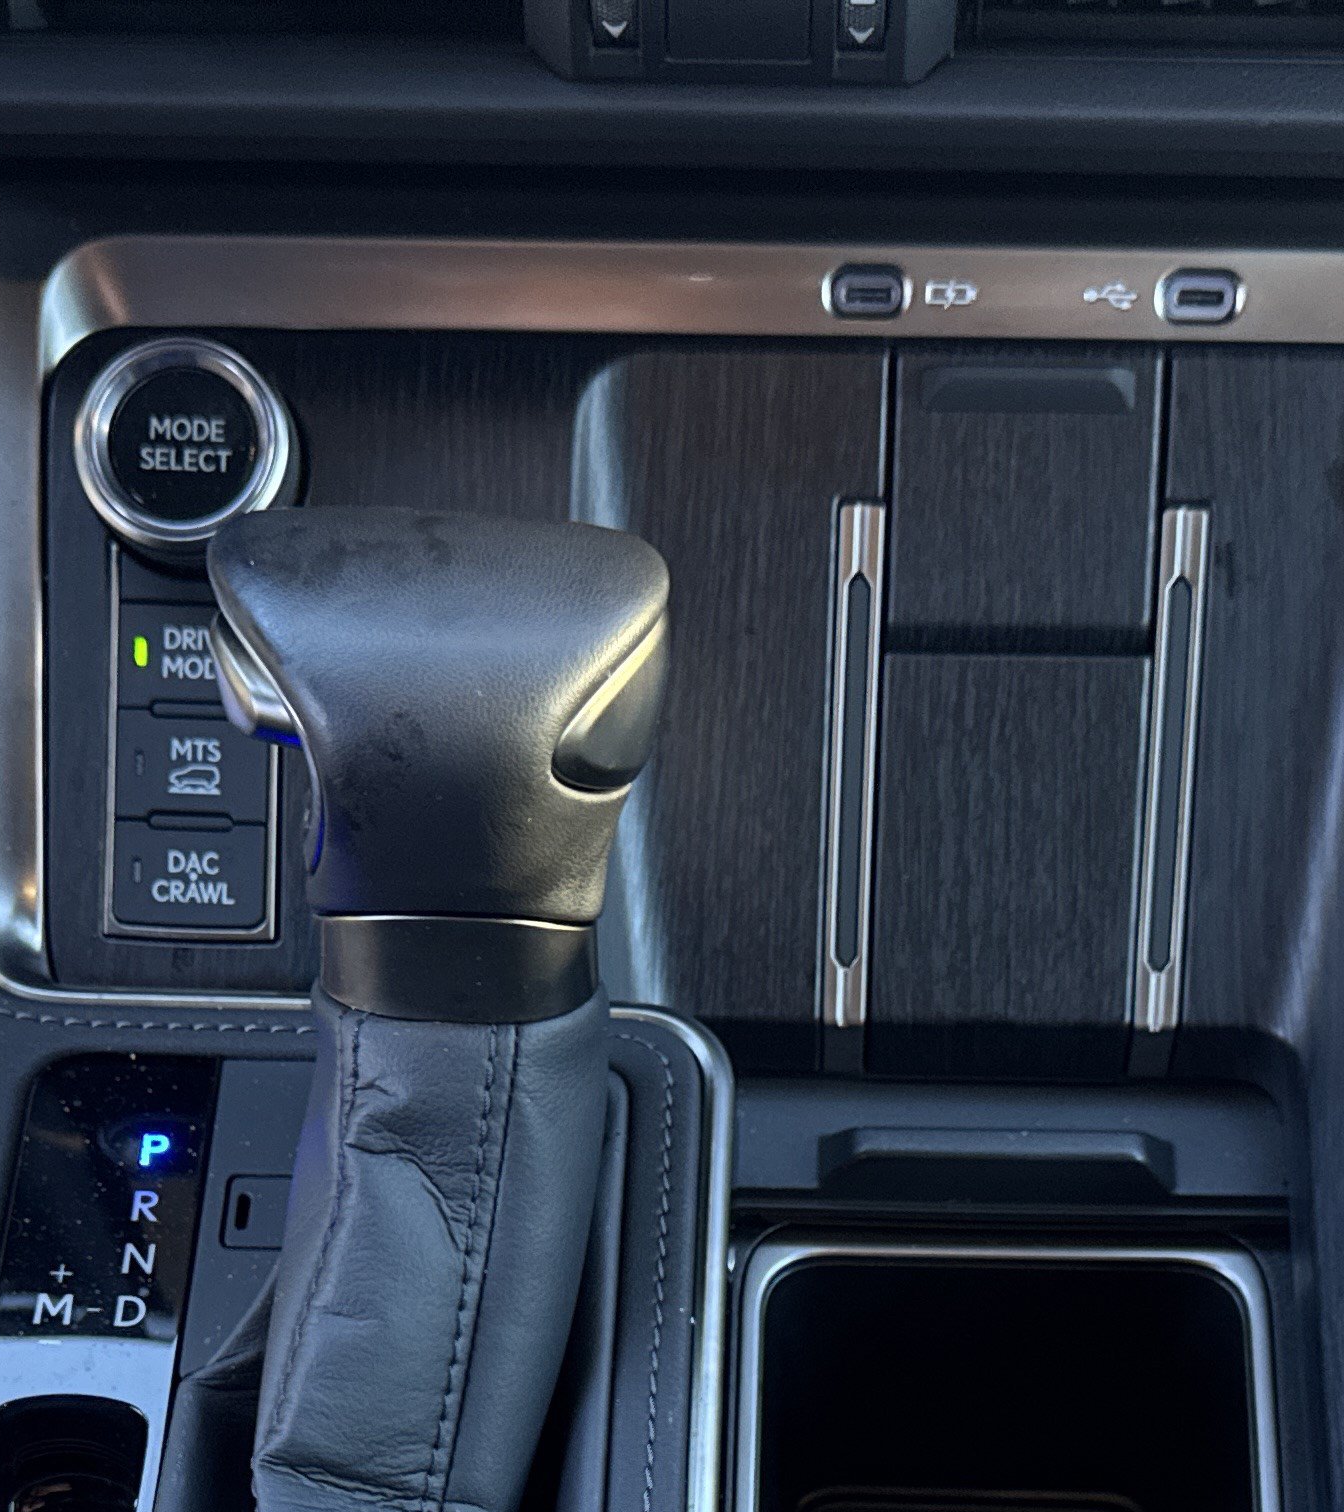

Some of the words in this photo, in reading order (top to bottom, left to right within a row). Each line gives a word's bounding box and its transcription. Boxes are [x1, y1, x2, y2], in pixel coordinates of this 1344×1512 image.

[149, 417, 225, 442] MODE
[140, 446, 232, 474] SELECT
[170, 740, 221, 764] MTS
[168, 851, 219, 875] DAC
[152, 880, 234, 905] CRAWL
[138, 1133, 170, 1166] P
[130, 1190, 160, 1222] R
[121, 1243, 157, 1275] N
